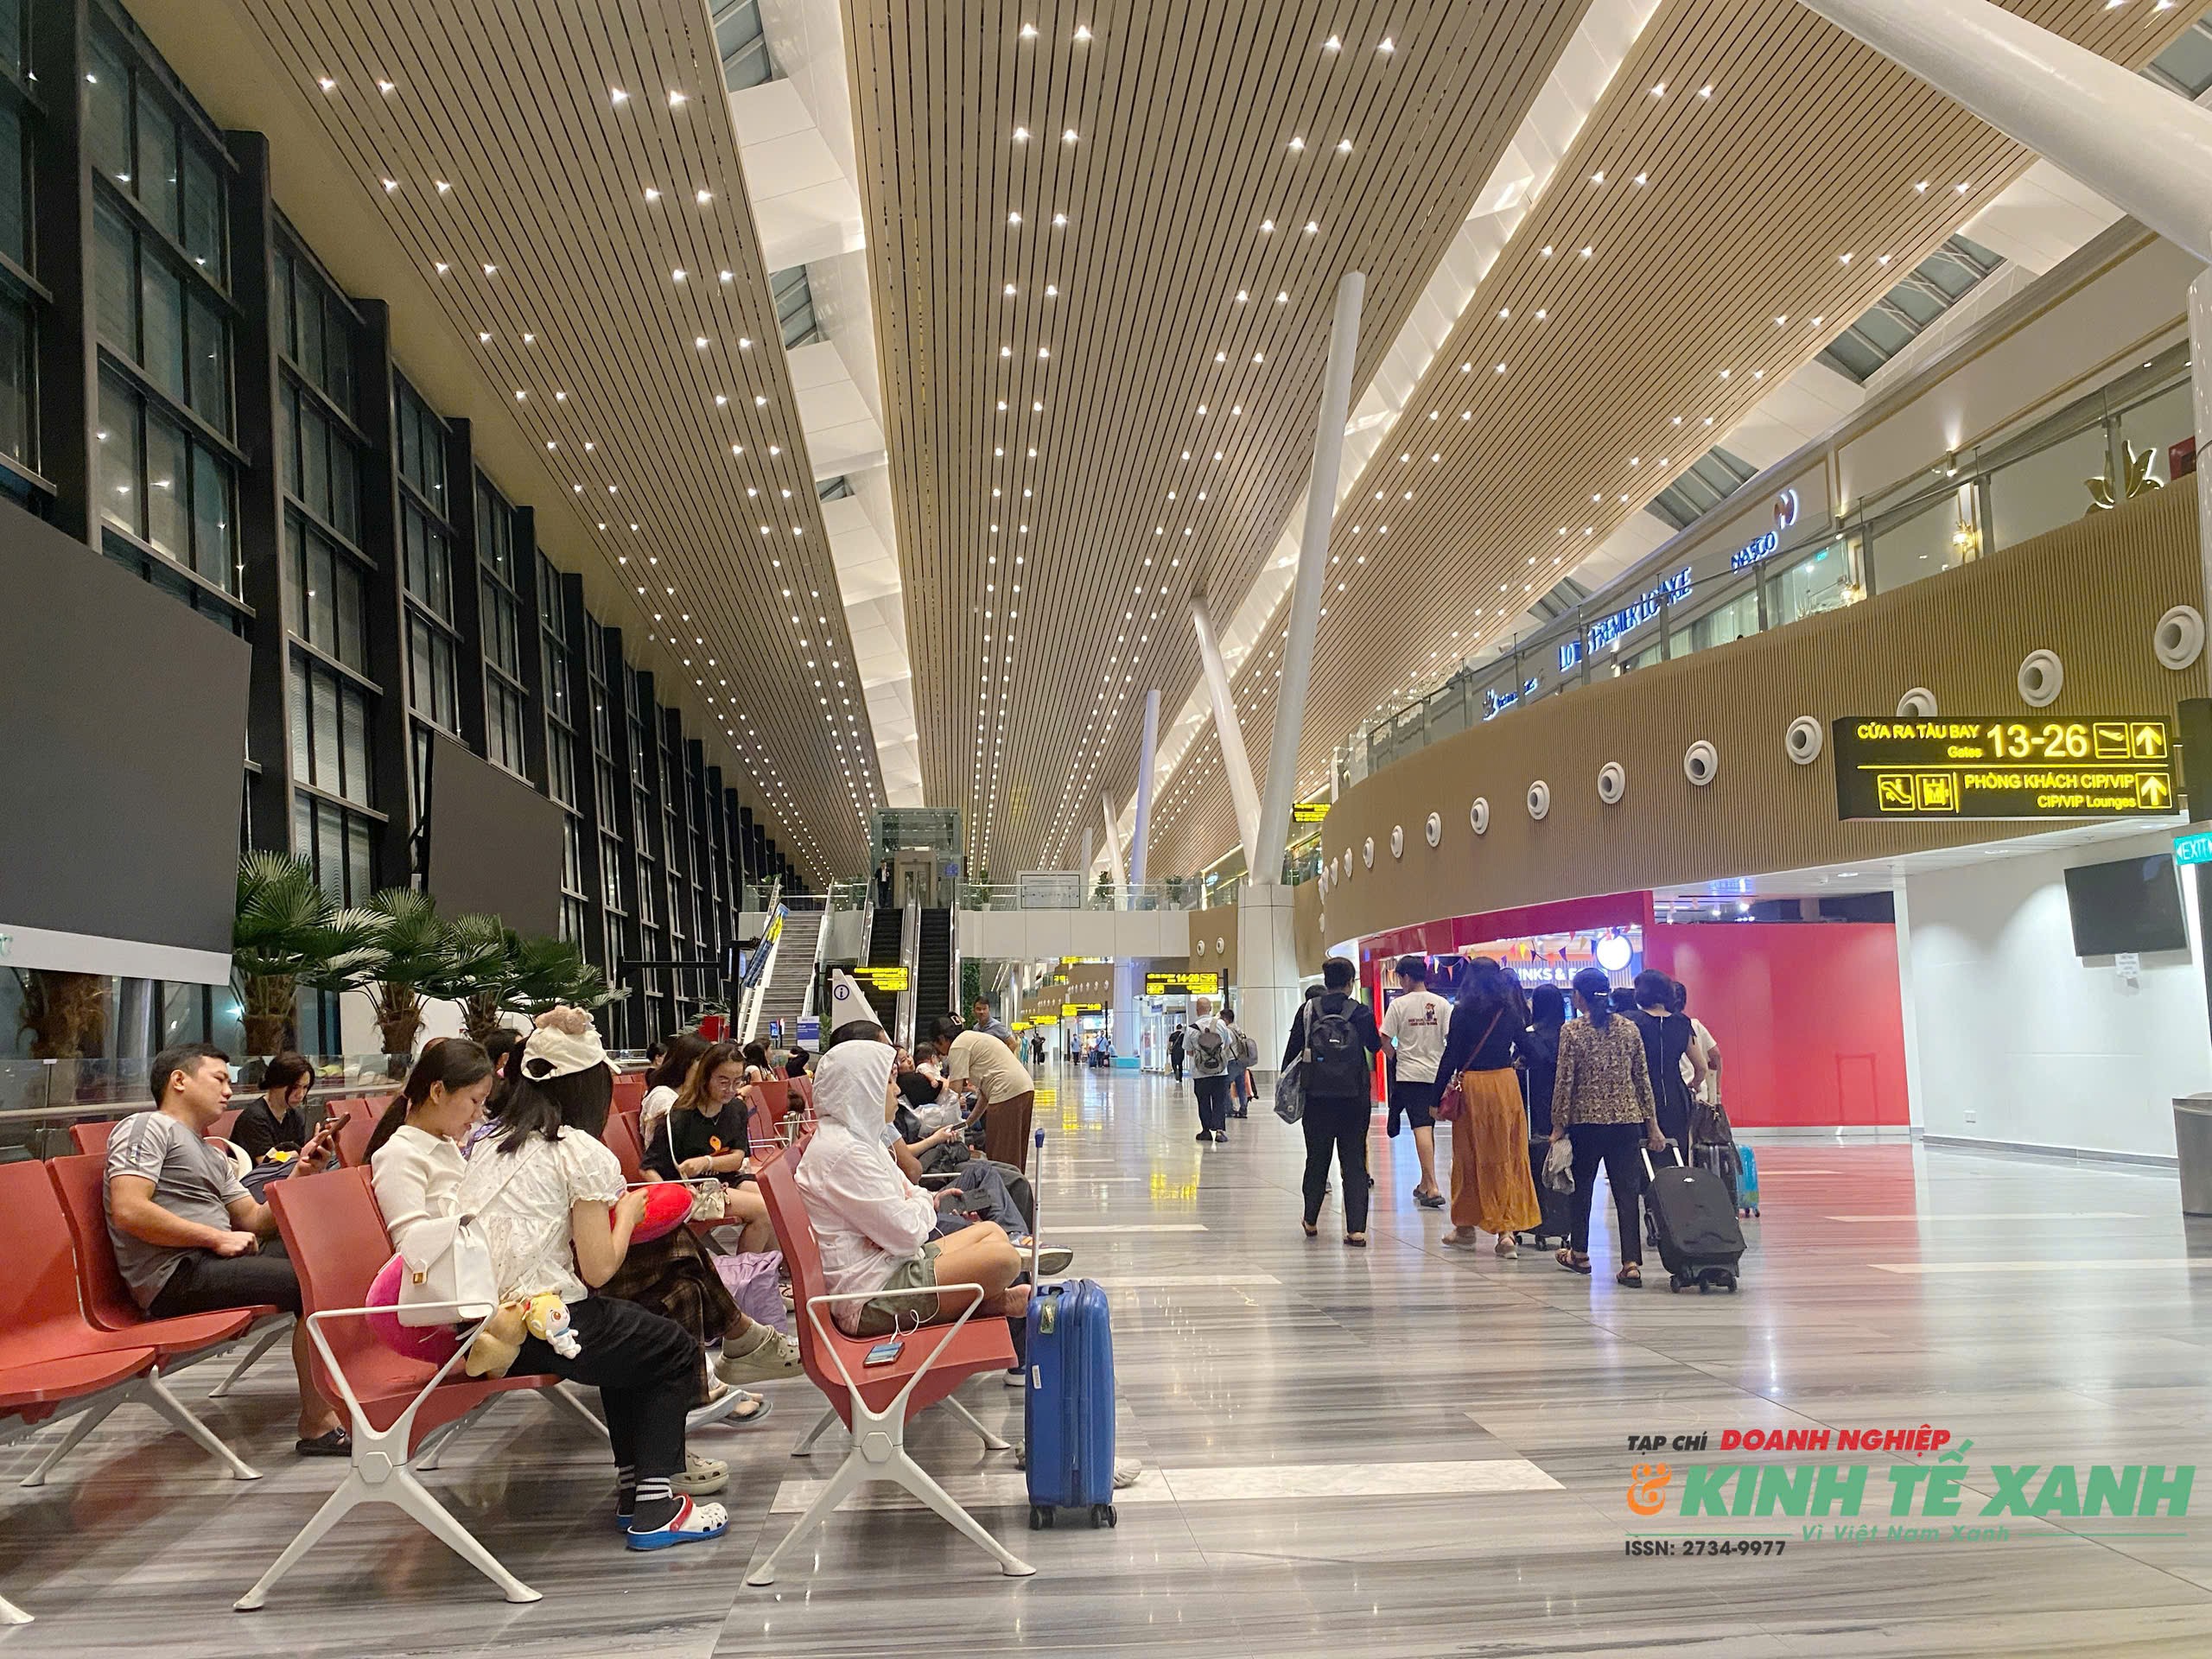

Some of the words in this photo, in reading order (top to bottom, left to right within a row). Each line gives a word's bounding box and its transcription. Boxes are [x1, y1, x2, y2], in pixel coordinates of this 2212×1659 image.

[1857, 721, 1891, 739] CỬA
[1892, 724, 1916, 739] RA
[1916, 721, 1947, 739] TÀU
[1949, 724, 1980, 739] BAY
[1986, 723, 2088, 758] 13-26
[1947, 745, 1983, 759] Gates
[1964, 772, 2021, 790] PHÒNG
[2024, 771, 2078, 790] KHÁCH
[2080, 773, 2135, 790] CIP/VIP
[2037, 795, 2083, 809] CIP/VIP
[2086, 795, 2137, 810] Lounges
[2182, 838, 2209, 861] EXIT
[1554, 967, 1567, 981] &
